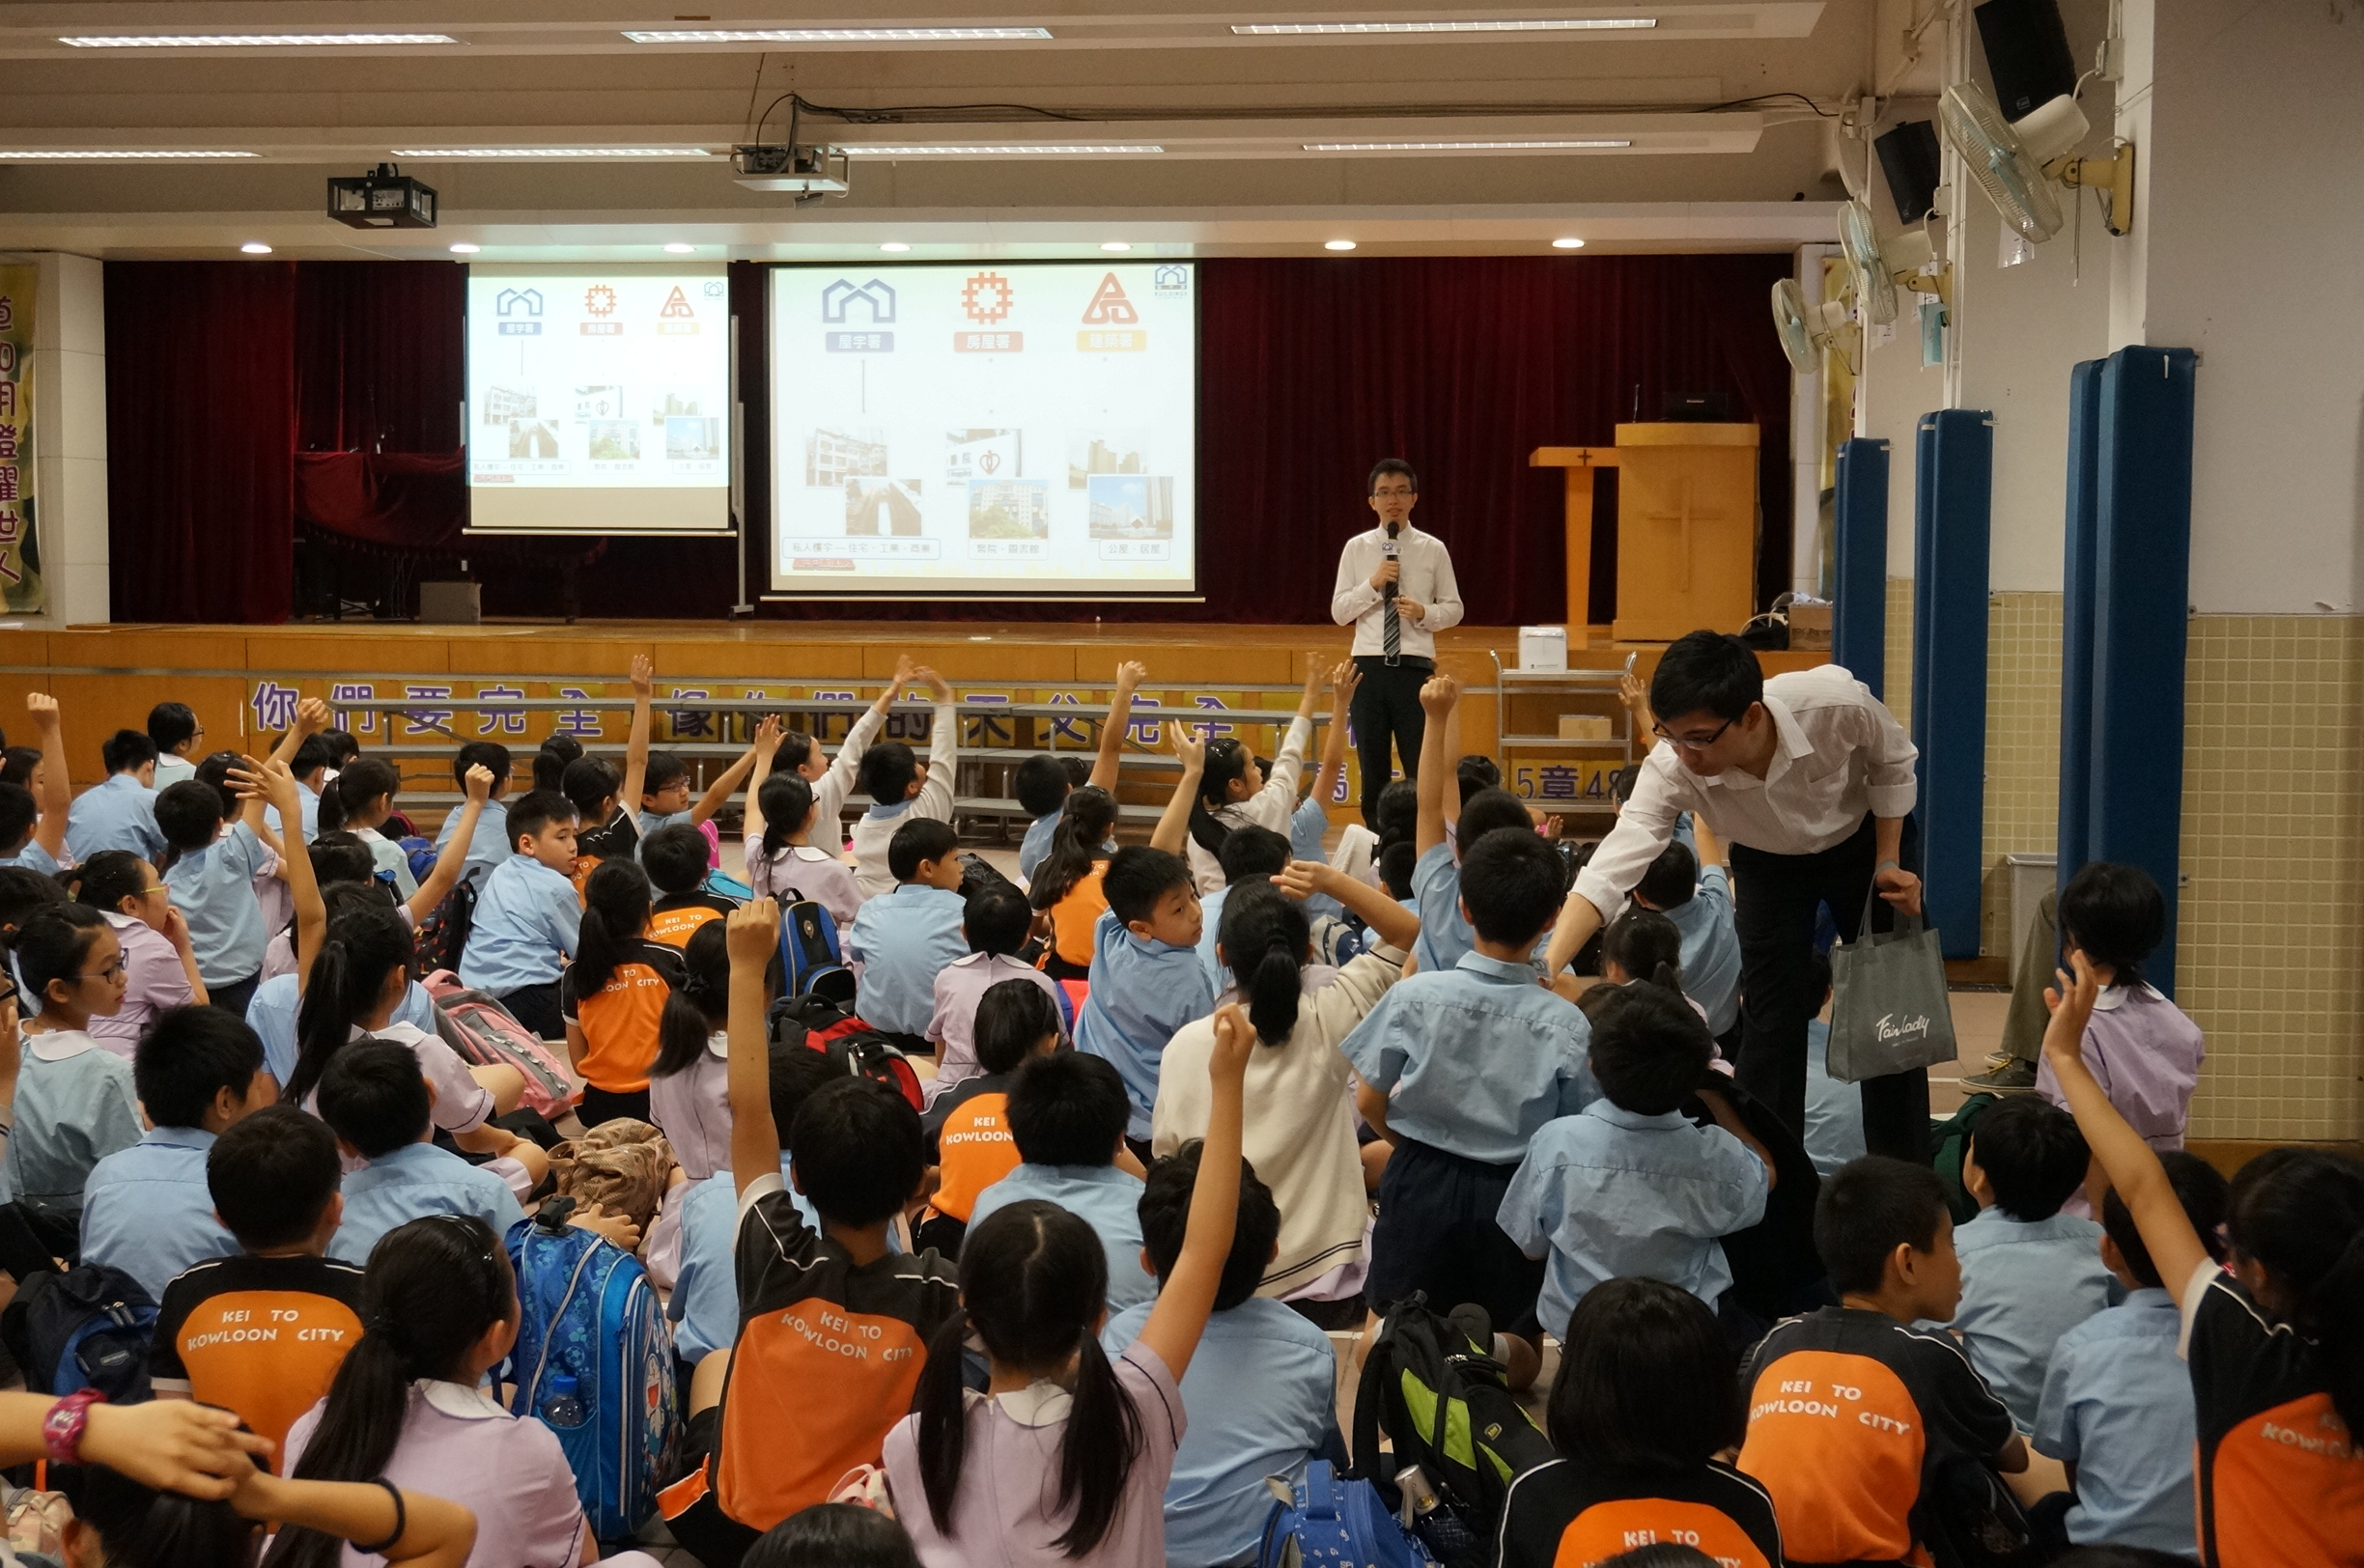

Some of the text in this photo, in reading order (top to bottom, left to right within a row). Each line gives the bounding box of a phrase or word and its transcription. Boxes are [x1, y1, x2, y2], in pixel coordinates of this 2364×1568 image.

[838, 335, 883, 350] 屋宇署
[967, 335, 1011, 350] 房屋署
[1088, 334, 1134, 349] 建築署
[623, 968, 636, 977] TO
[636, 978, 660, 988] CITY
[973, 1117, 996, 1127] KEI
[945, 1131, 1014, 1145] KOWLOON
[222, 1309, 299, 1324] KEI TO
[820, 1310, 883, 1340] KEI TO
[187, 1328, 345, 1352] KOWLOON CITY
[780, 1313, 868, 1359] KOWLOON
[1780, 1381, 1863, 1401] KEI TO
[1858, 1412, 1910, 1436] CITY
[1623, 1529, 1701, 1548] KEI TO
